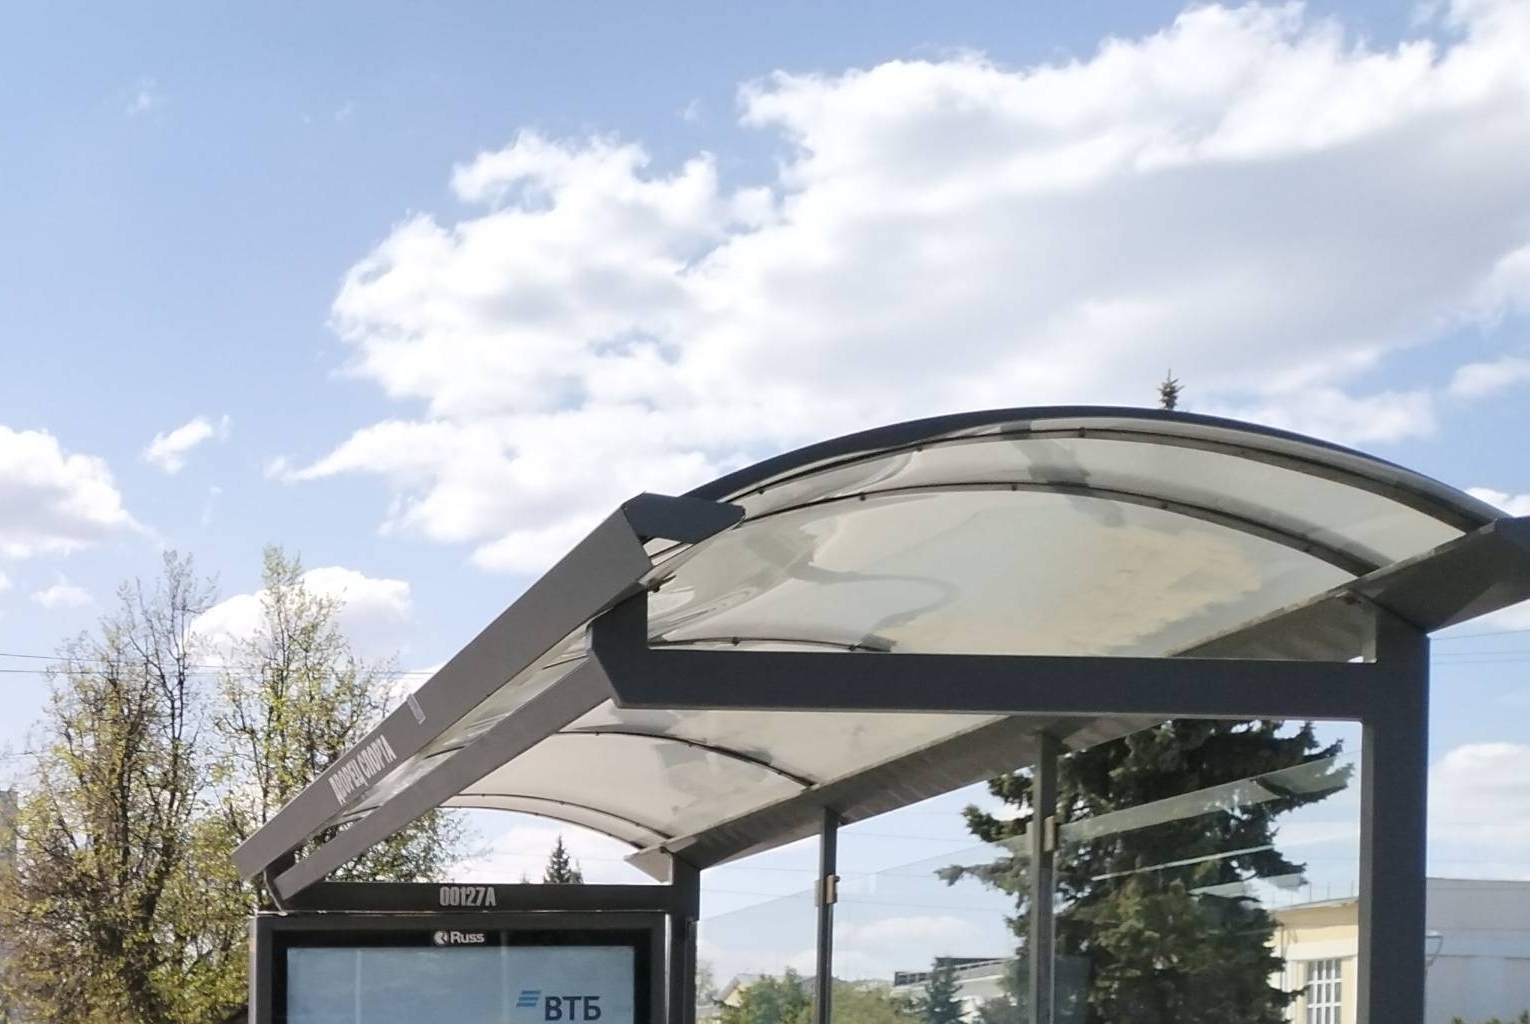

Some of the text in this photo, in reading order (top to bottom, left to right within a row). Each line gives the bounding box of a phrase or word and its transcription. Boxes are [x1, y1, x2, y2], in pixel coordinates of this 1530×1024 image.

[328, 734, 397, 805] ДВОРЕЦ СПОРТА
[449, 931, 485, 944] Russ
[544, 996, 602, 1021] ВТБ
